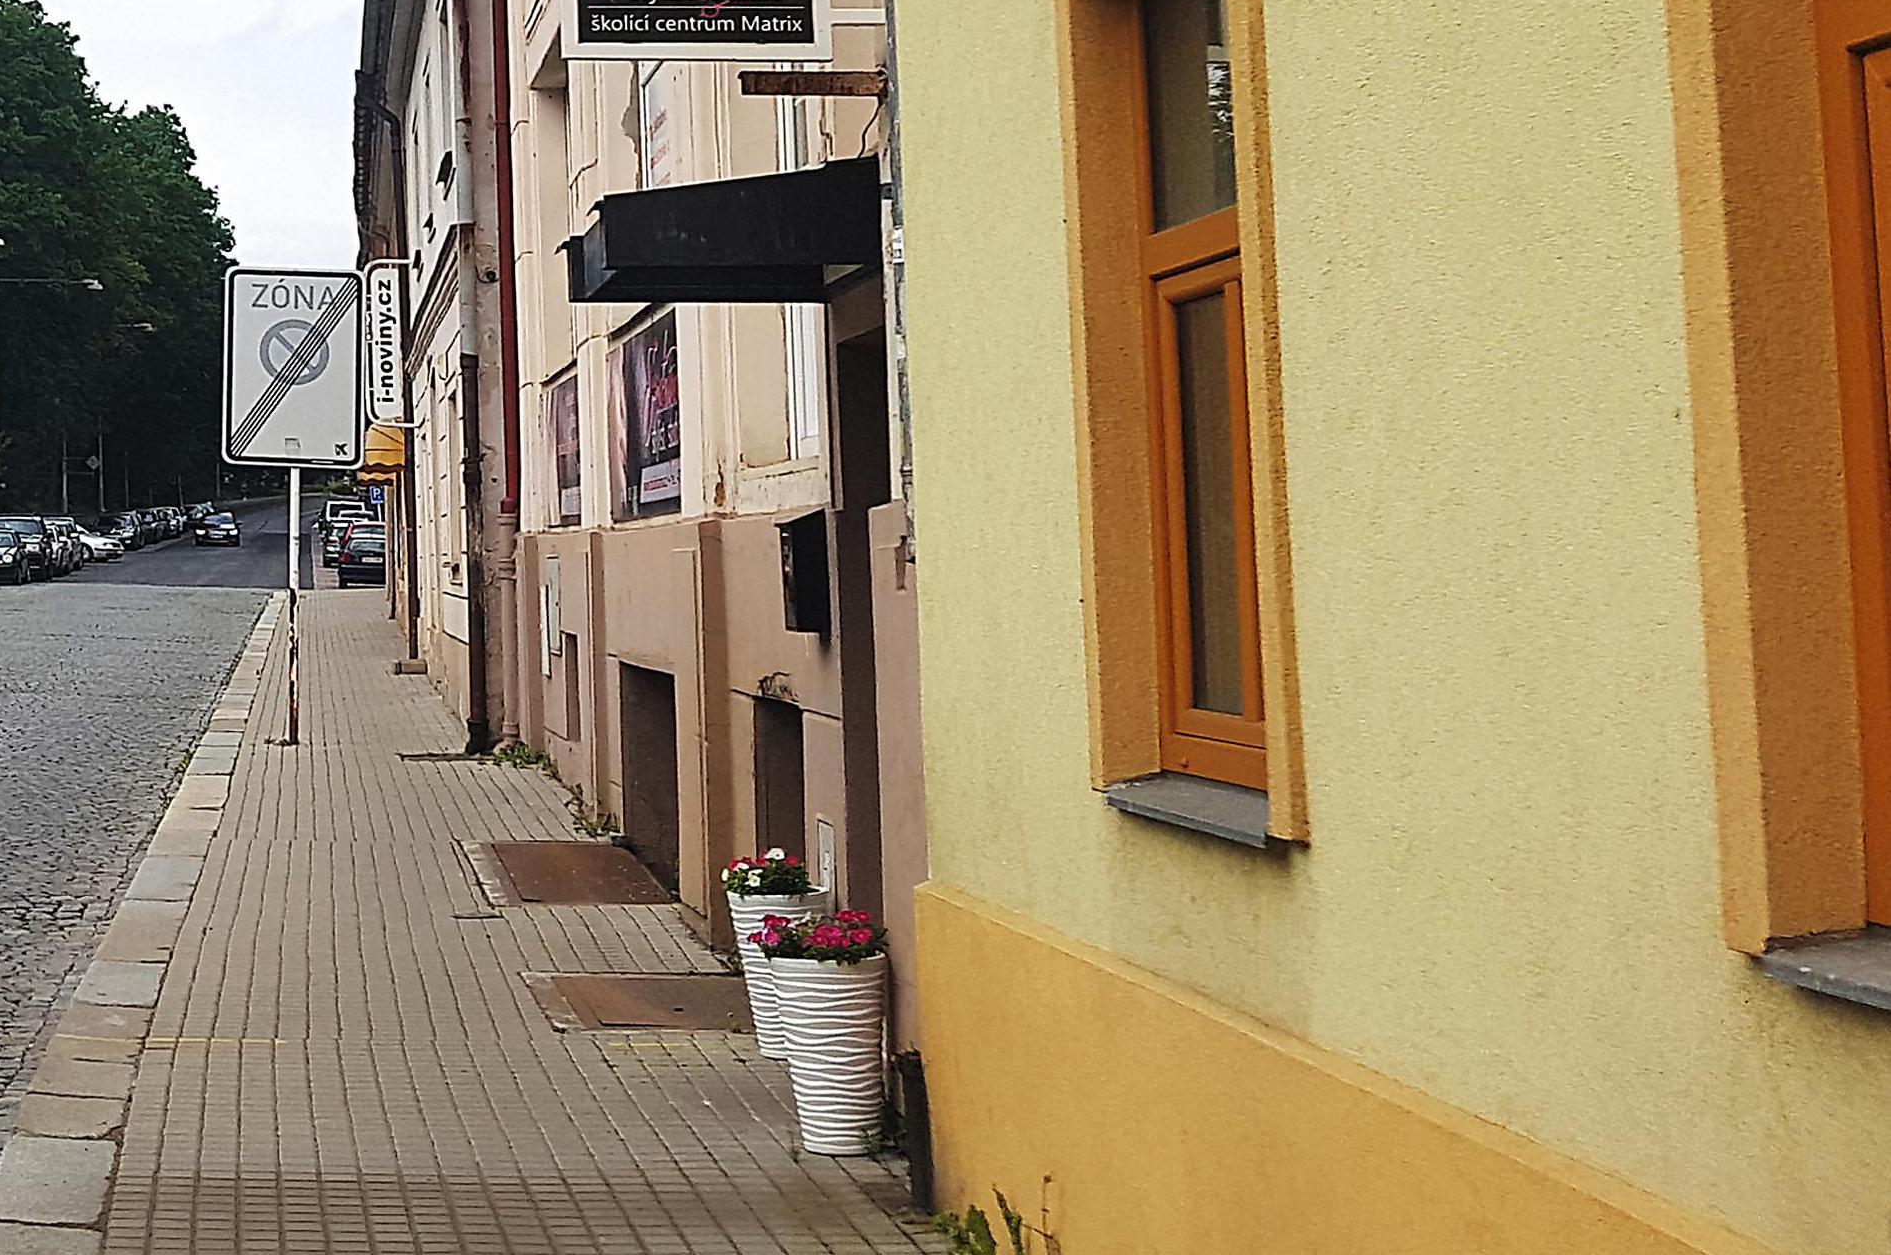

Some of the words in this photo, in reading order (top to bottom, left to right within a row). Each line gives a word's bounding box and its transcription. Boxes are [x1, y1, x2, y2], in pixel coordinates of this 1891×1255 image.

[591, 13, 650, 32] školící
[655, 17, 735, 32] centrum
[741, 15, 803, 32] Matrix
[251, 278, 338, 311] ZÓNA
[375, 278, 397, 403] i-noviny.cz
